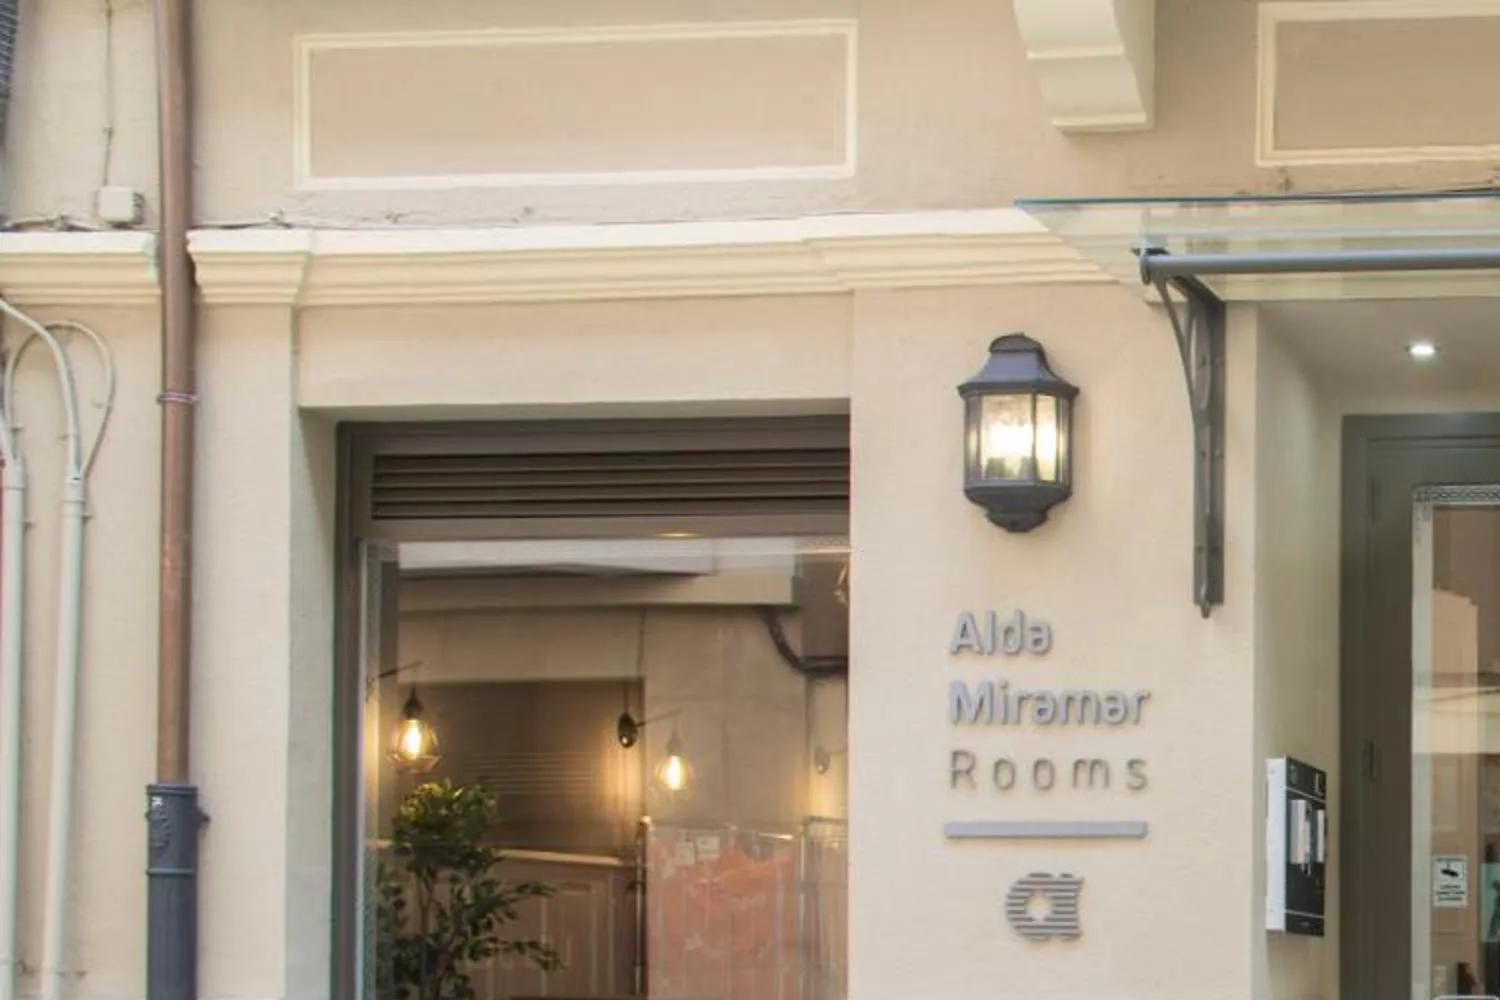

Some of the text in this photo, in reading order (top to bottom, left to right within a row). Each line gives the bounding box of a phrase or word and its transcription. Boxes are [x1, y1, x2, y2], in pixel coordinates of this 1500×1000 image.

[949, 609, 1053, 656] Alda
[949, 679, 1151, 725] Miramar
[949, 750, 1149, 791] Rooms
